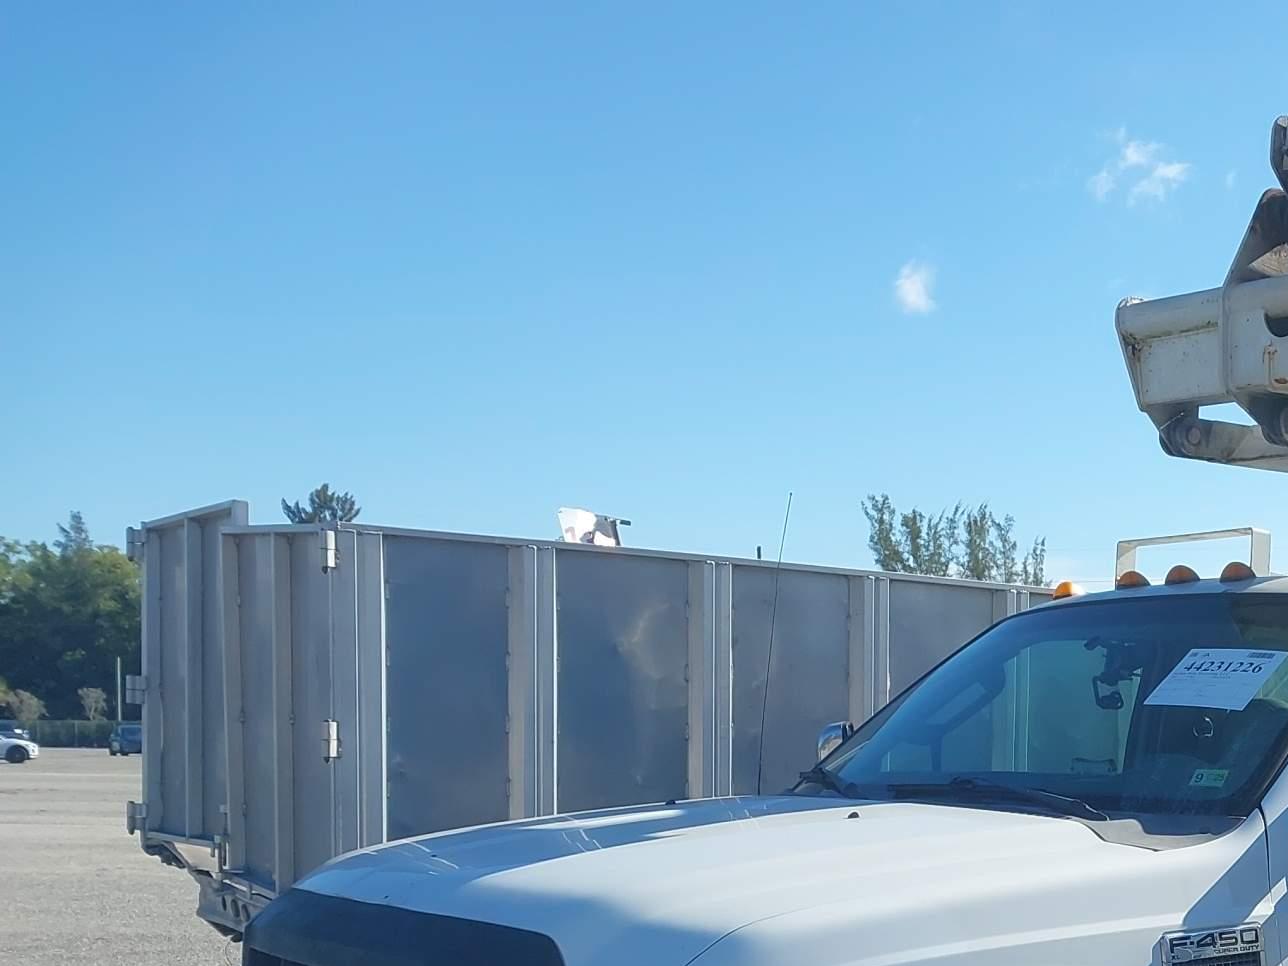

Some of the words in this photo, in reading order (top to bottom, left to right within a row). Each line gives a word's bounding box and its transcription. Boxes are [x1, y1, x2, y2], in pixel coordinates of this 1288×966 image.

[1184, 660, 1264, 674] 44231226
[1194, 773, 1205, 783] 9
[1168, 928, 1260, 954] F-450
[1239, 944, 1260, 953] DUTY
